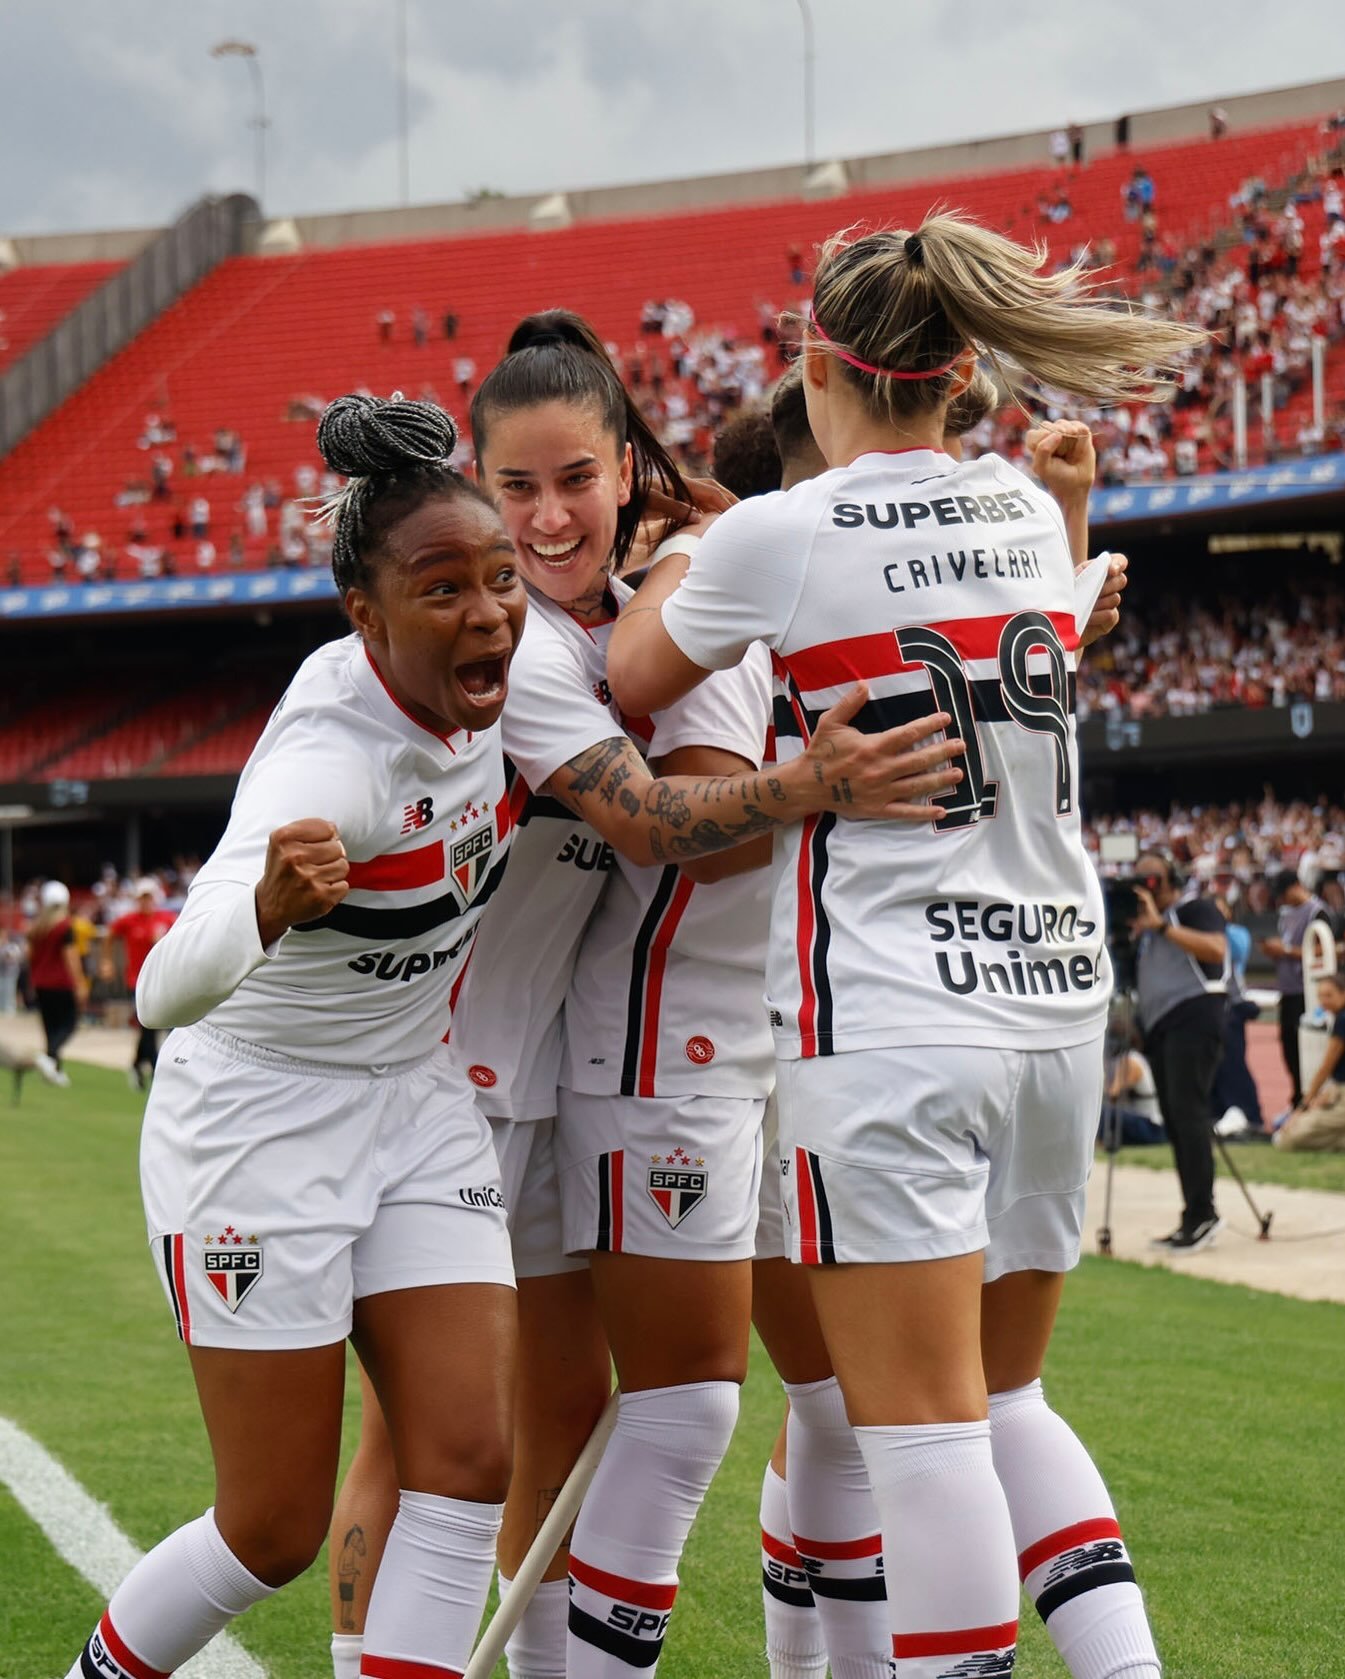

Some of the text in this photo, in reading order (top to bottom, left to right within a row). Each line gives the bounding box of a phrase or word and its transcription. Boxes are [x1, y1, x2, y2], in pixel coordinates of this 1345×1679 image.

[832, 488, 1036, 530] SUPERBET
[883, 548, 1042, 593] CRIVELARI
[893, 609, 1072, 833] 19
[454, 830, 491, 864] SPFC
[652, 1173, 703, 1188] SPFC
[206, 1254, 257, 1268] SPFC
[91, 1634, 131, 1679] SP
